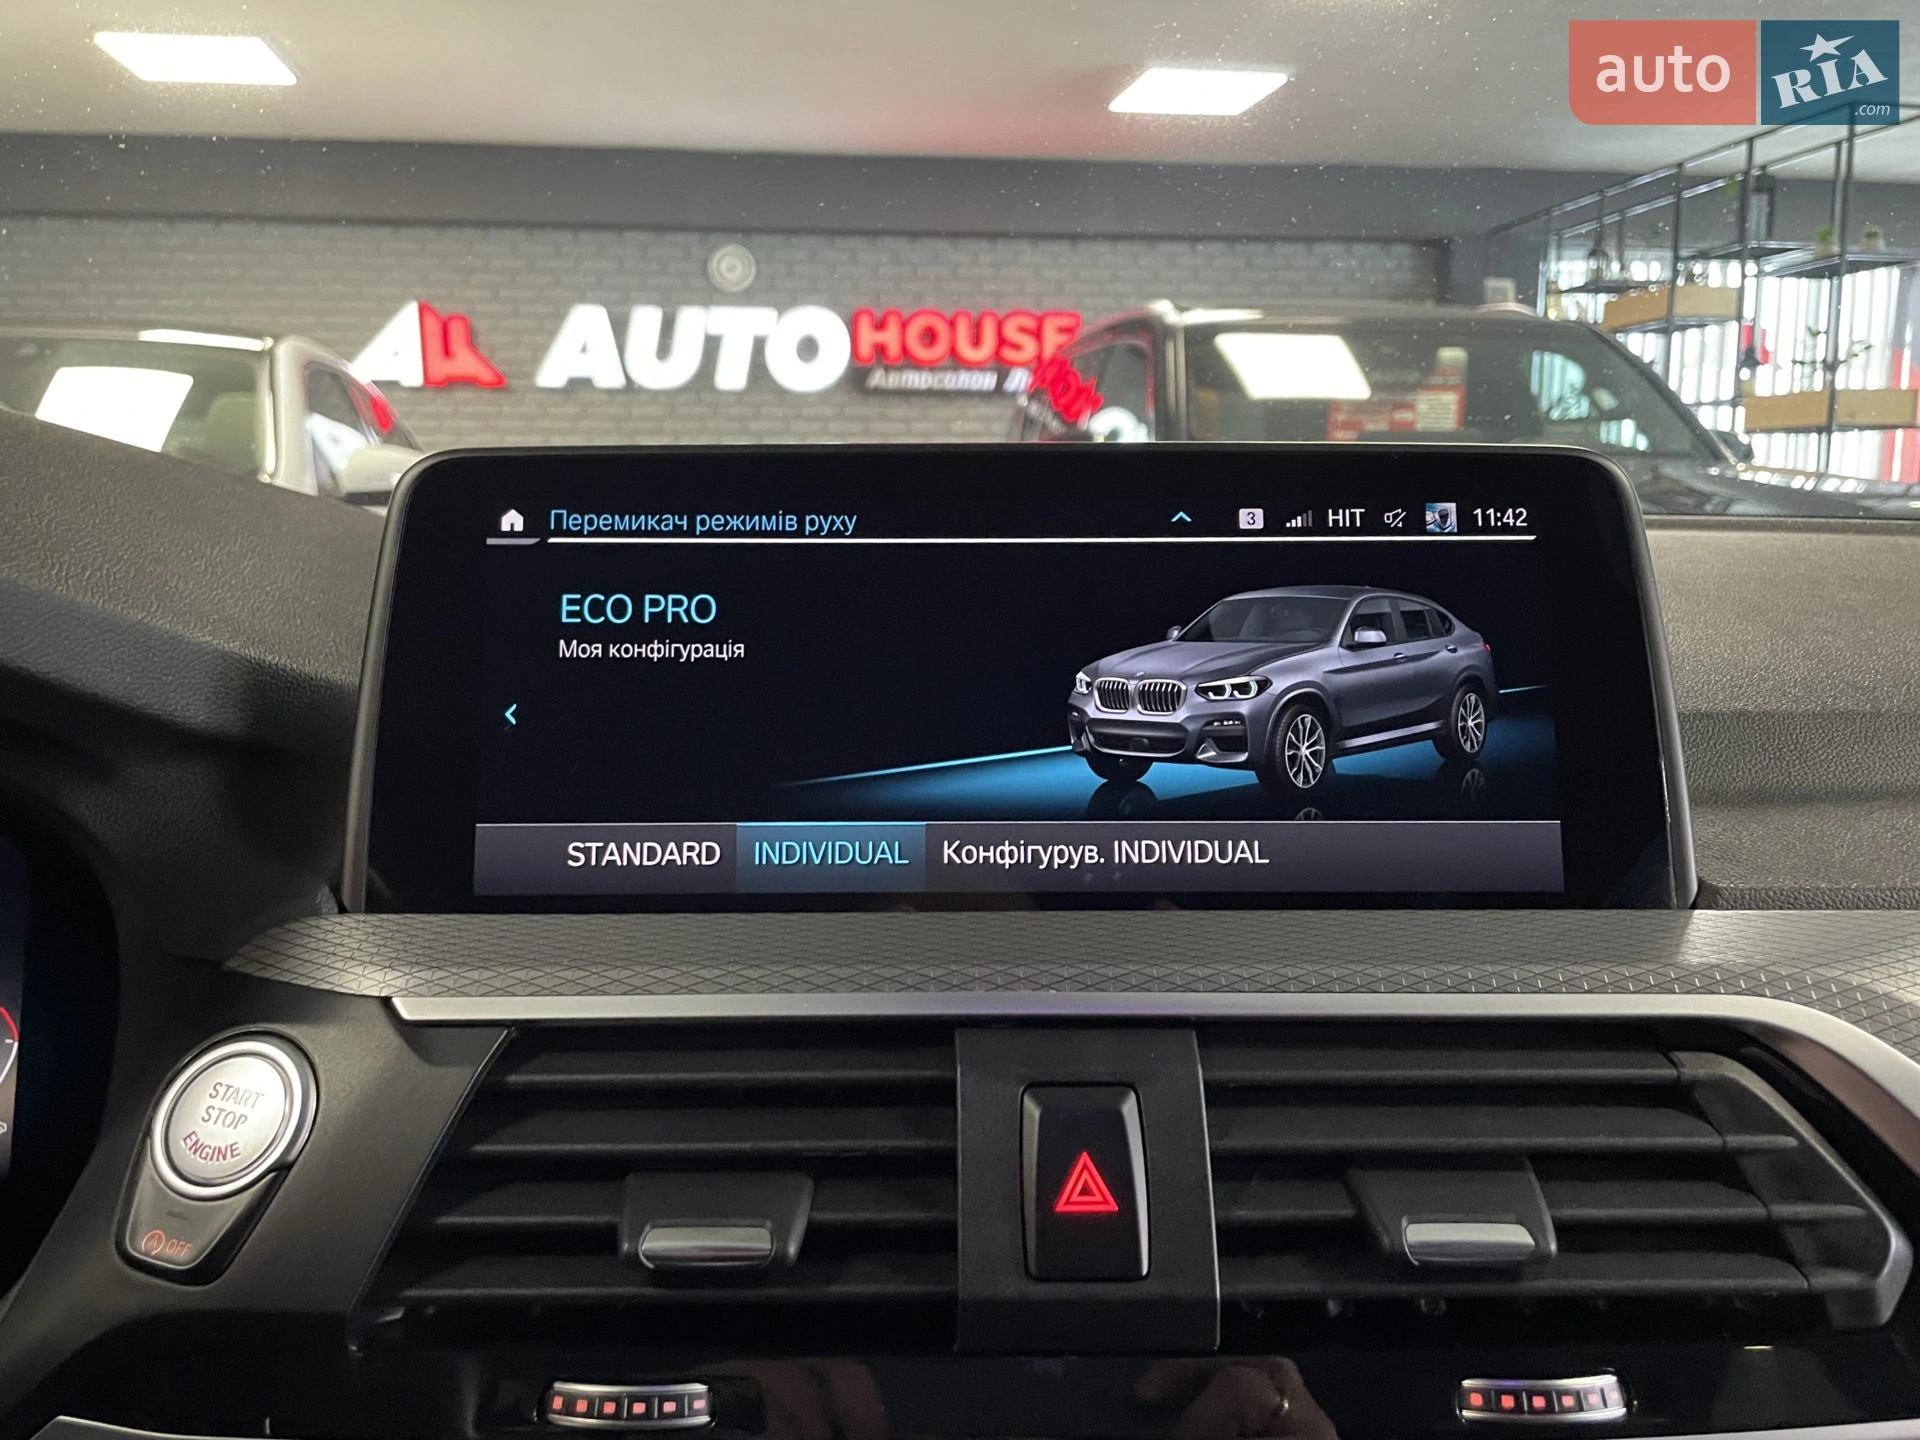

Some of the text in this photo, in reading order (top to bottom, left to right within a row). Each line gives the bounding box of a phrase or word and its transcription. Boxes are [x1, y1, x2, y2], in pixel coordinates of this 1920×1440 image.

[536, 304, 852, 392] AUTO
[549, 509, 858, 536] Перемикач режимів руху
[1328, 508, 1366, 528] HIT
[1472, 507, 1529, 528] 11:42
[560, 593, 717, 624] ECO PRO
[558, 638, 746, 663] Моя конфігурація
[566, 841, 721, 867] STANDARD
[753, 840, 910, 866] INDIVIDUAL
[941, 840, 1269, 869] Конфігурув. INDIVIDUAL
[208, 1082, 264, 1110] START
[201, 1105, 248, 1130] STOP
[182, 1130, 241, 1163] ENGINE
[166, 1238, 193, 1257] OFF
